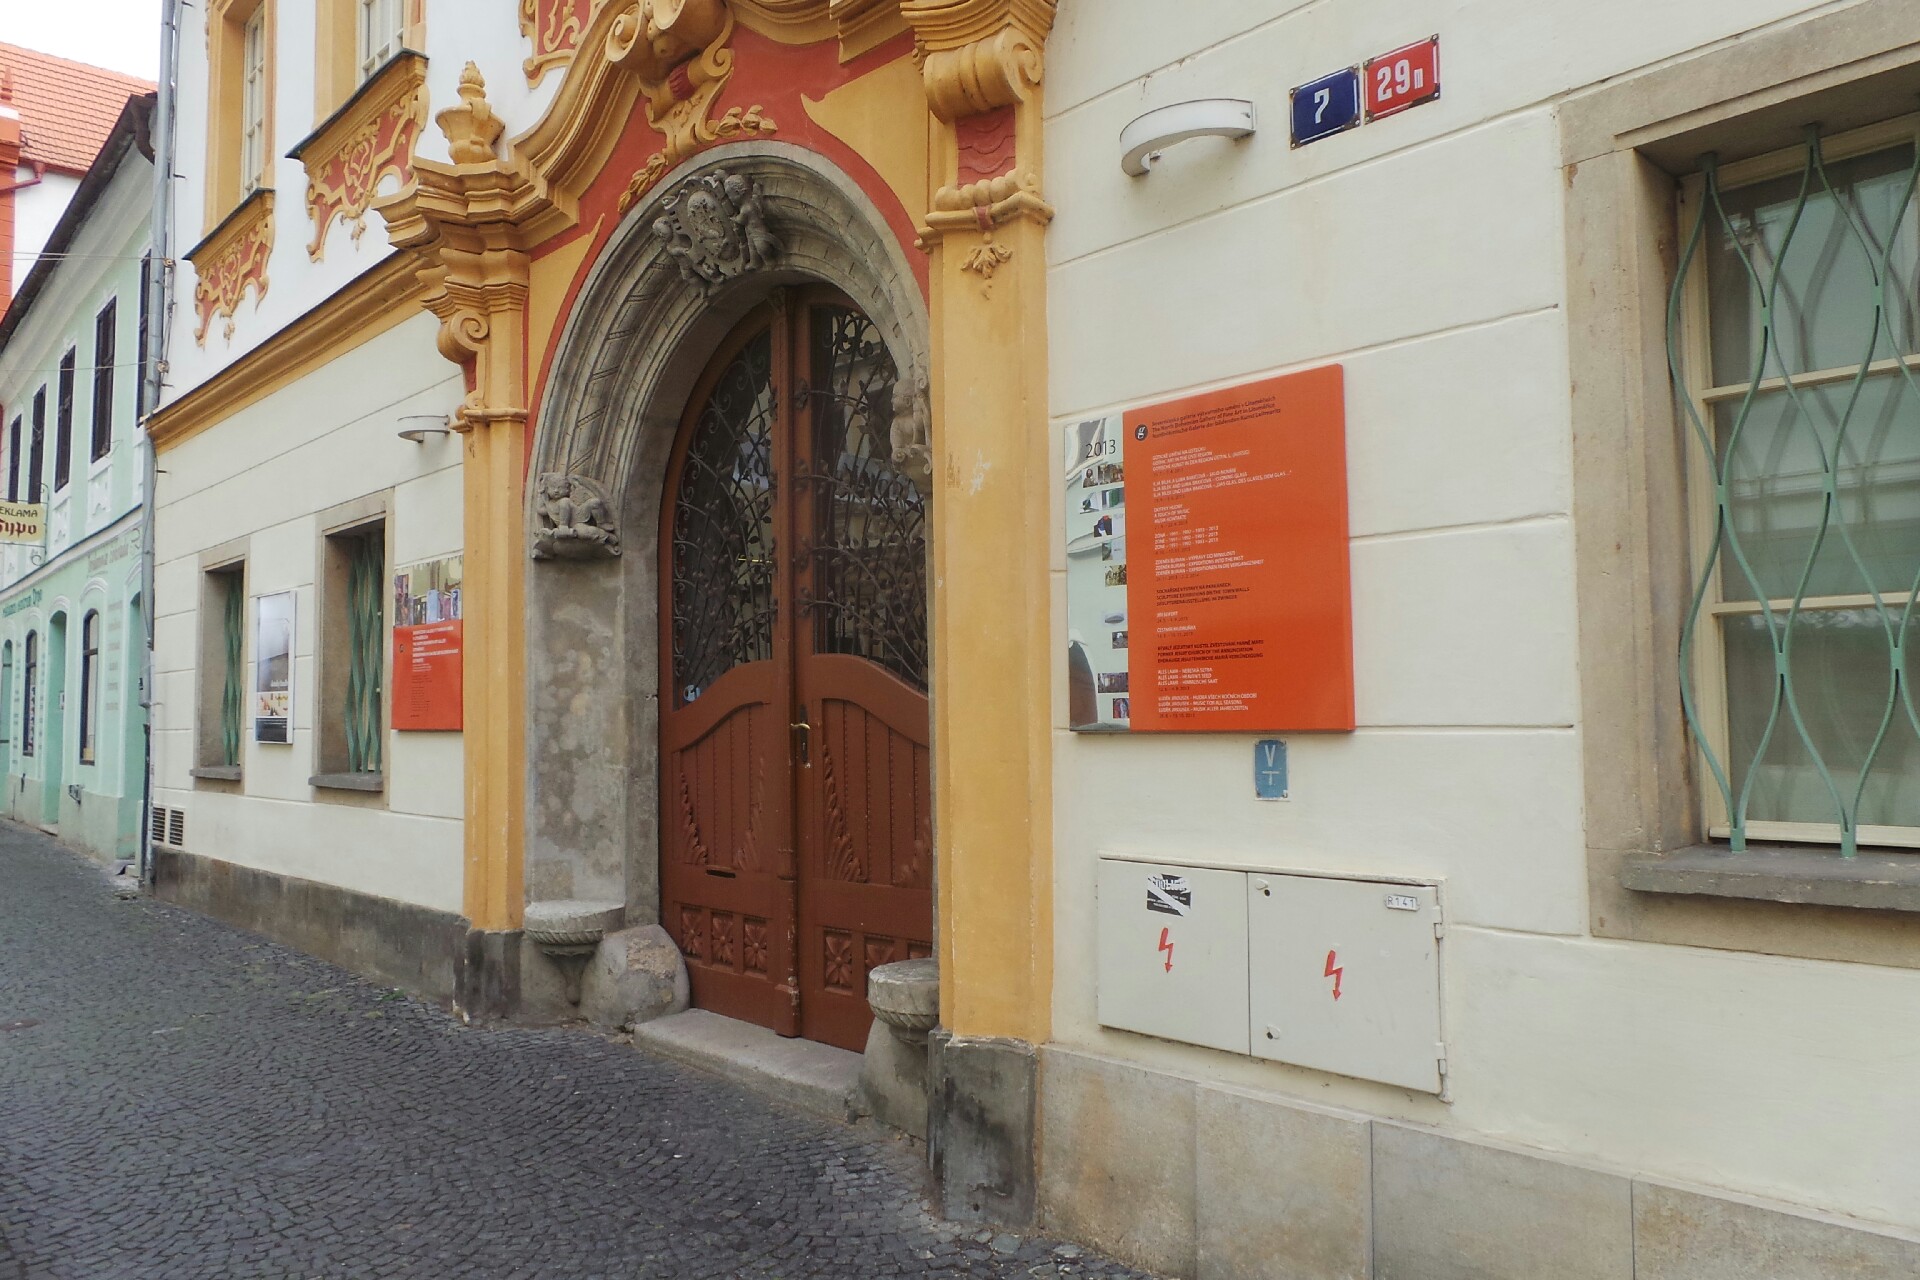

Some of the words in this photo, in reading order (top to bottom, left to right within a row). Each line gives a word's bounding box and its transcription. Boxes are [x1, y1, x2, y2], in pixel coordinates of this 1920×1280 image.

[1314, 87, 1330, 124] 7
[1085, 439, 1116, 459] 2013
[1264, 744, 1276, 768] V
